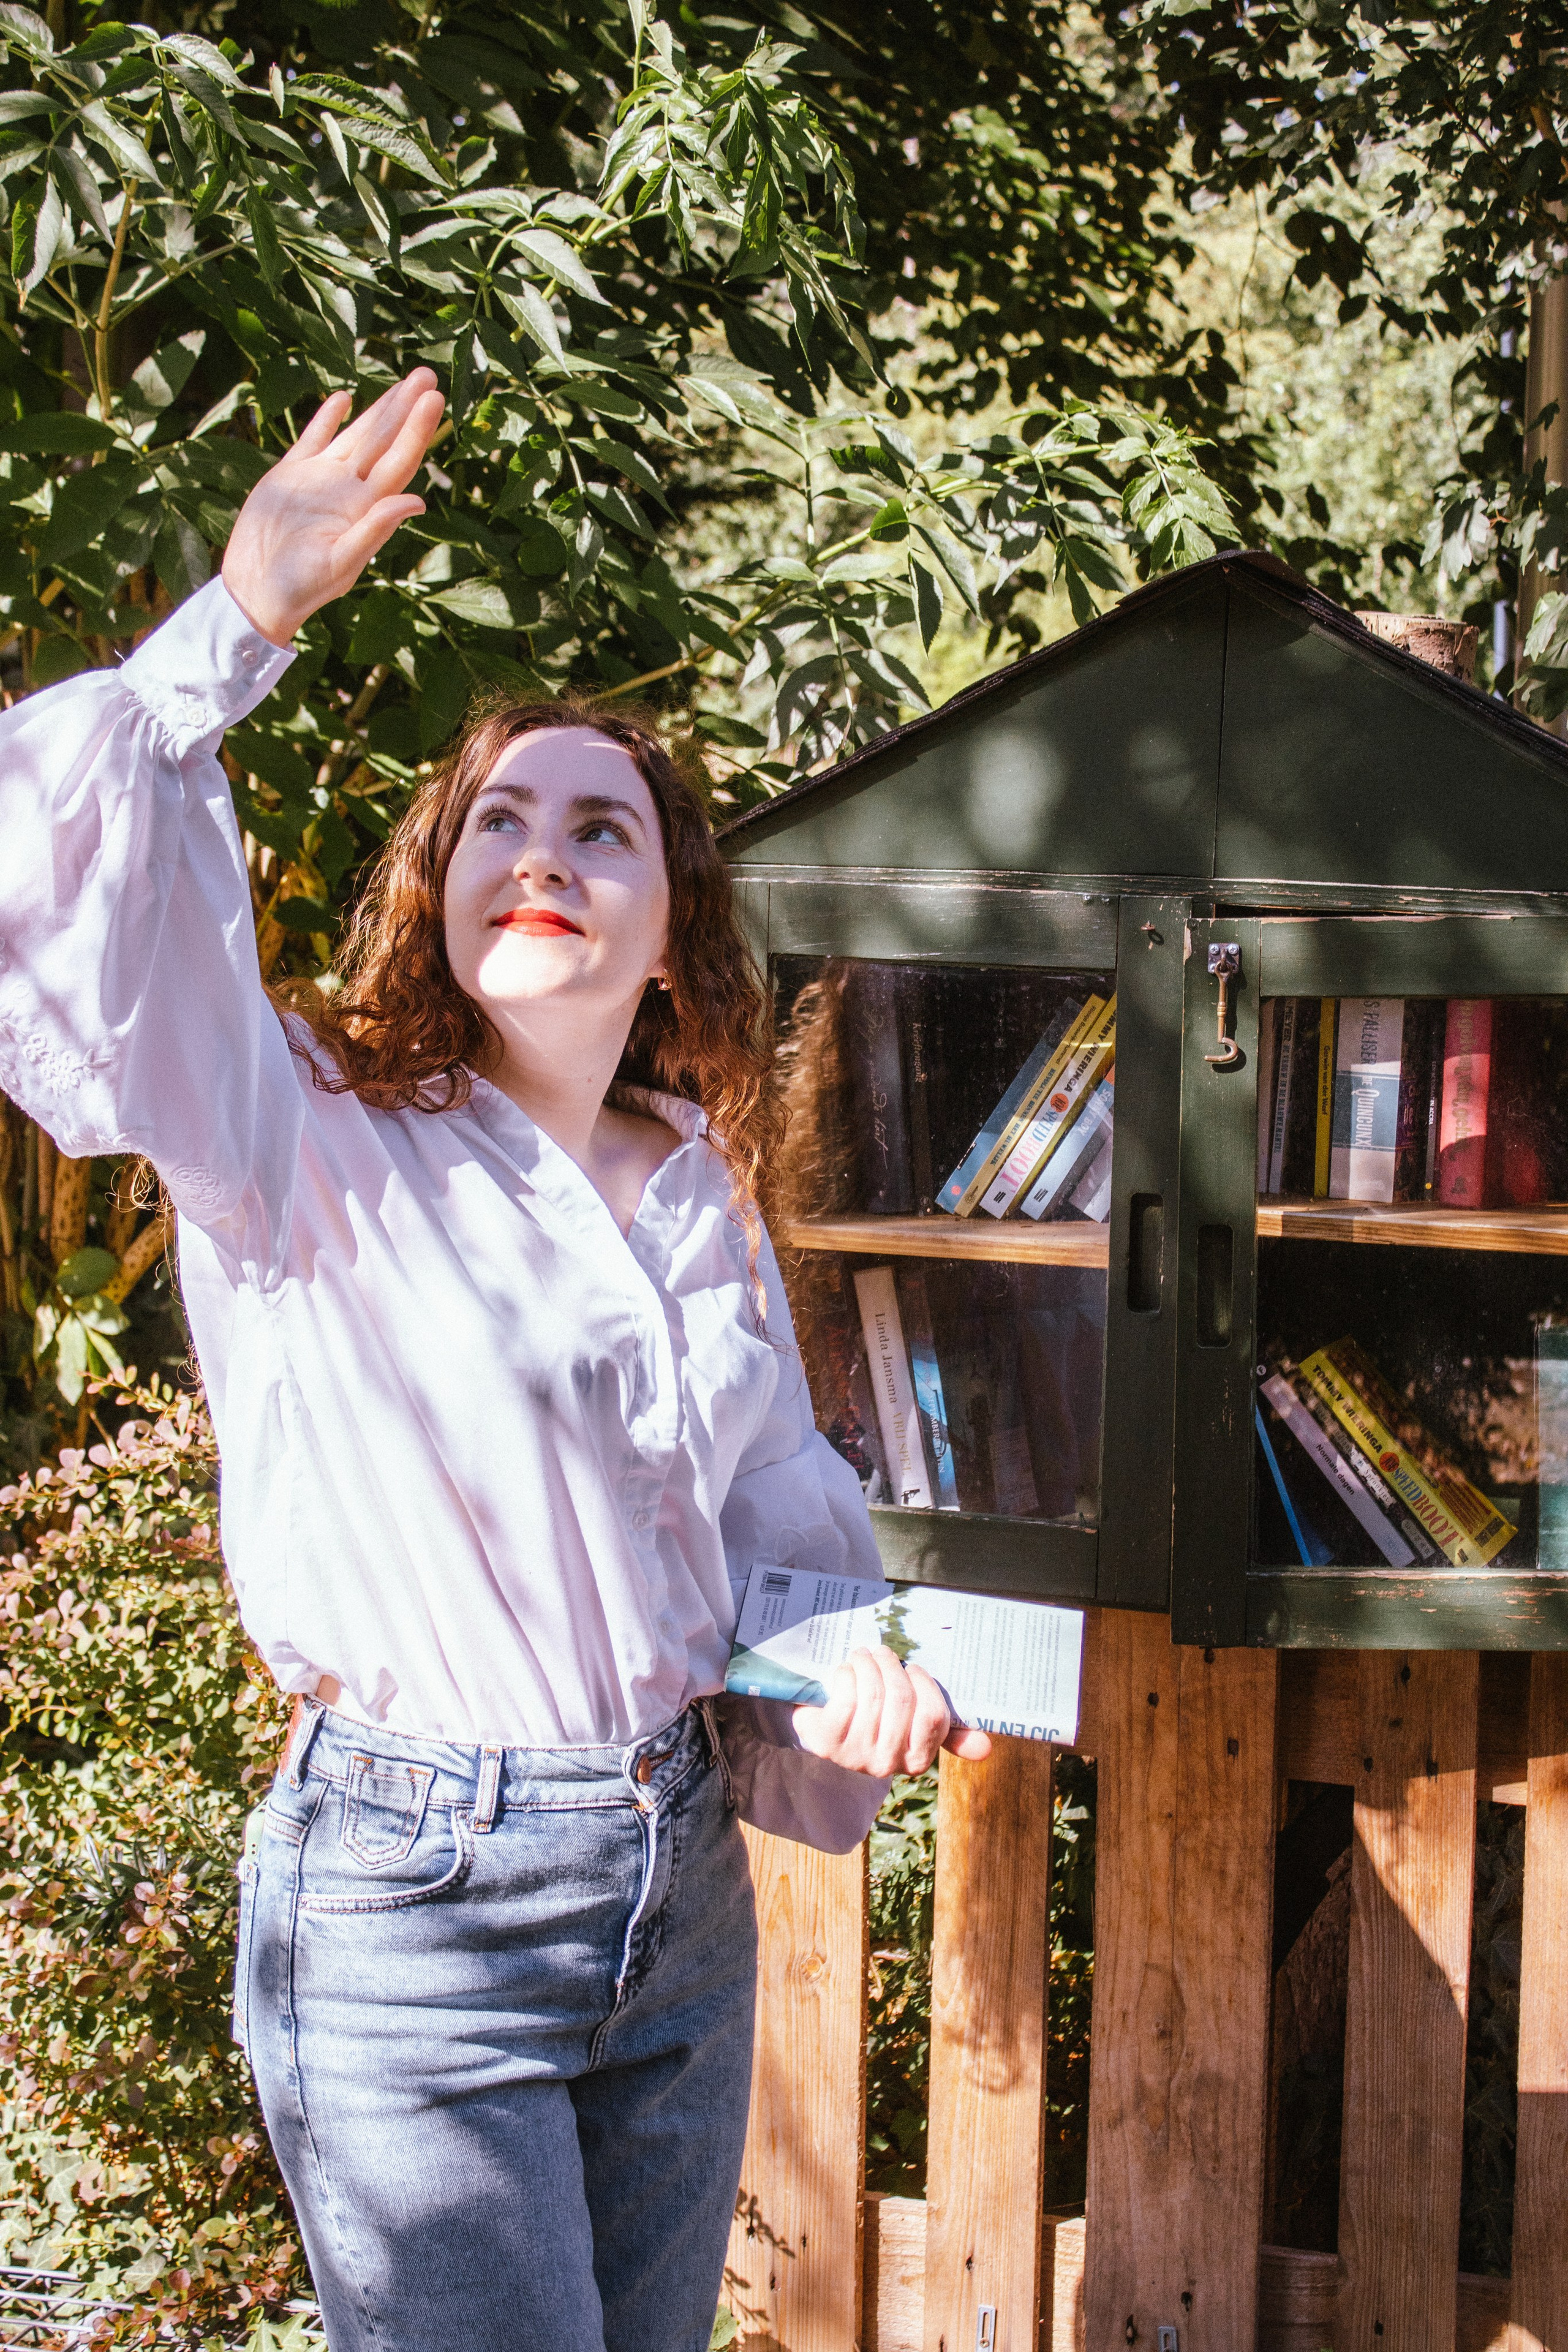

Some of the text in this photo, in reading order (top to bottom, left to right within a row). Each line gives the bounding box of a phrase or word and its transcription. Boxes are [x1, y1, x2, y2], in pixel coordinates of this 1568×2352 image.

[1283, 1005, 1294, 1041] MEYER
[1360, 1012, 1379, 1065] PALLISER
[1063, 1041, 1100, 1093] WIERINGA
[1009, 1122, 1020, 1136] HET
[1076, 1116, 1093, 1136] BOY
[1349, 1077, 1380, 1146] DE QUINCUNX
[989, 1134, 1012, 1166] HUWELIJK
[996, 1095, 1068, 1193] JOE SPEEDBOOT
[875, 1312, 899, 1404] Linda Jansma
[1311, 1364, 1344, 1403] TOMMY
[1341, 1402, 1384, 1453] WIERINGA
[892, 1411, 913, 1476] VRIJ SPEL
[1315, 1444, 1340, 1474] Normale
[1336, 1472, 1355, 1496] dagen
[1362, 1468, 1392, 1503] Sprookjes
[1390, 1466, 1464, 1553] SPEEDBOOT
[850, 1592, 859, 1608] Italiaanse
[974, 1717, 993, 1732] IK
[999, 1721, 1025, 1737] EN
[1030, 1725, 1060, 1743] JIJ
